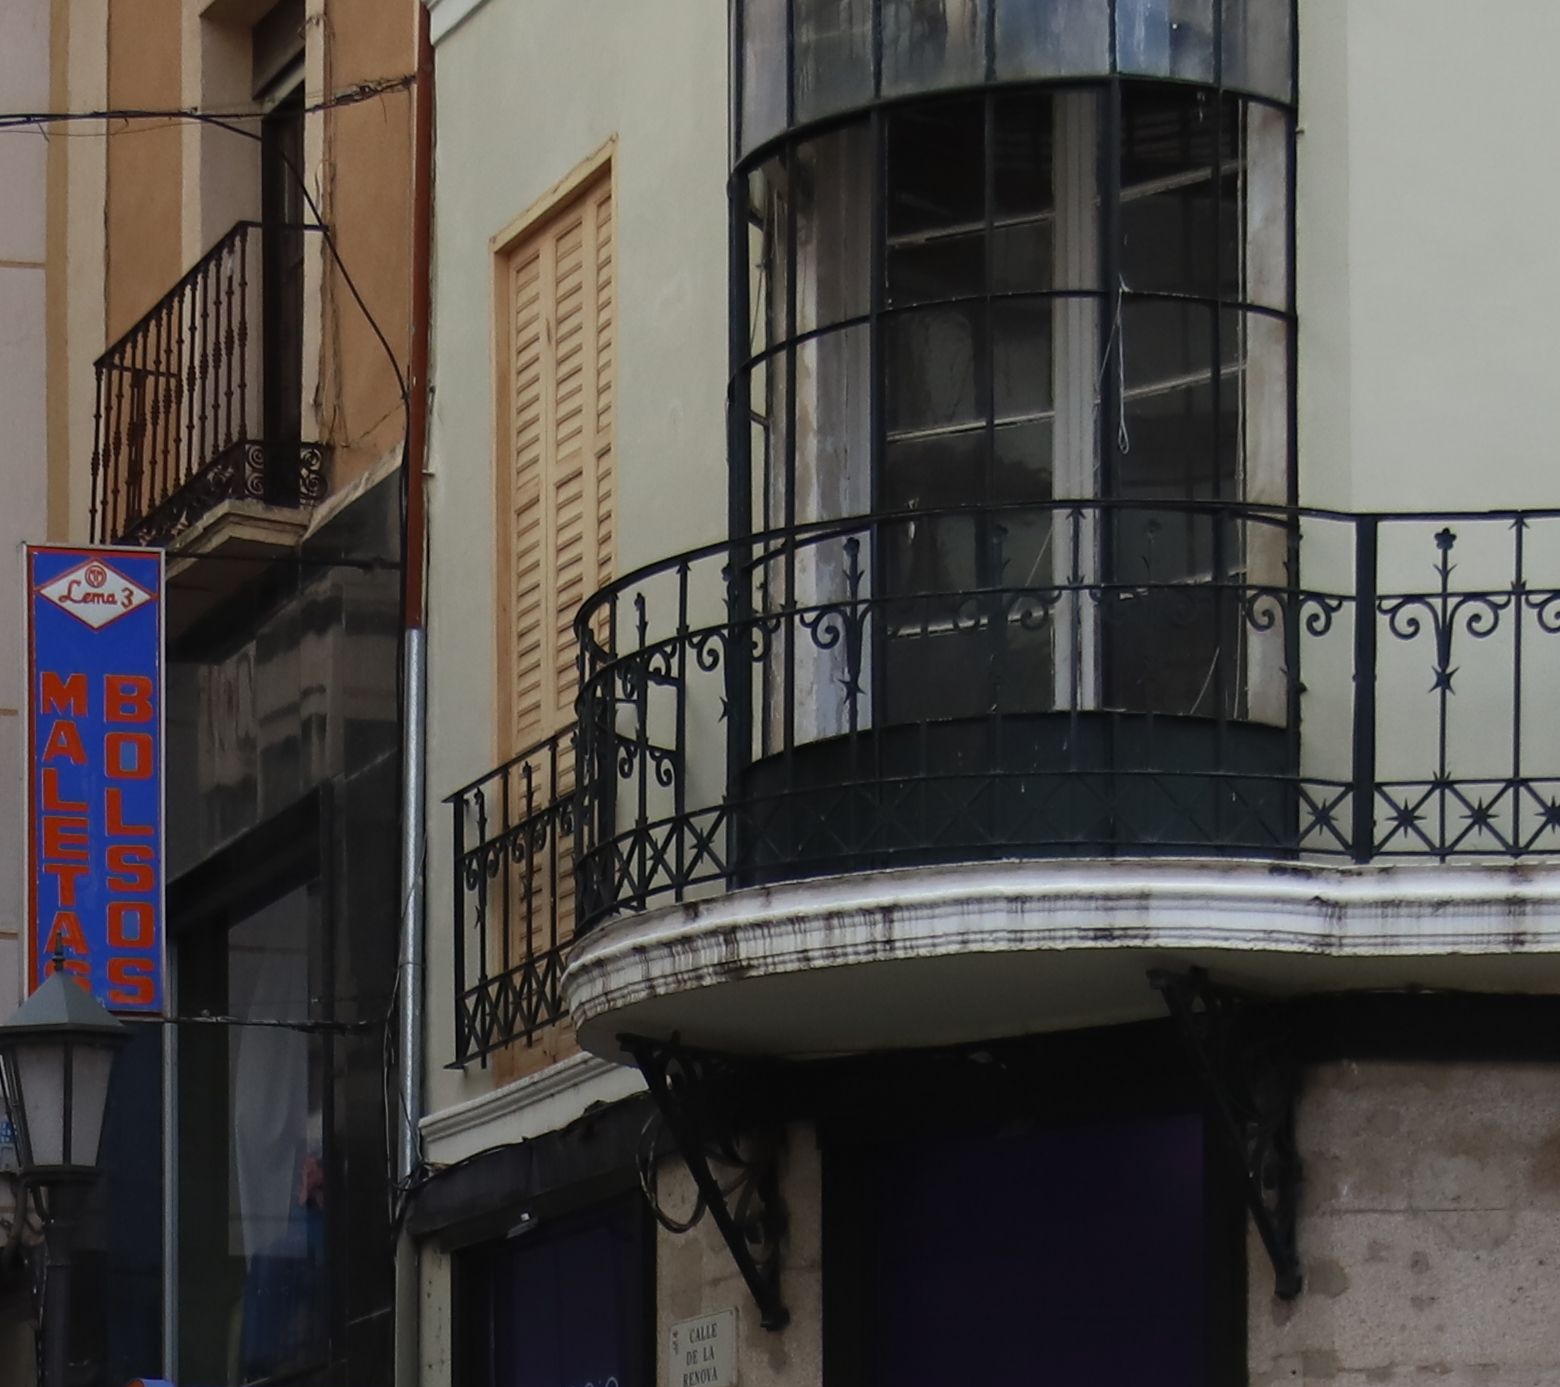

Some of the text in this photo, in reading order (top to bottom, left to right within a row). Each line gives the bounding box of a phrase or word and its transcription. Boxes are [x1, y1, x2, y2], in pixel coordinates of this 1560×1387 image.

[58, 580, 134, 609] Lema 3
[105, 674, 156, 1006] BOLSOS
[689, 1323, 718, 1343] CALLE
[686, 1345, 715, 1366] DE LA
[683, 1368, 718, 1387] RENOVA
